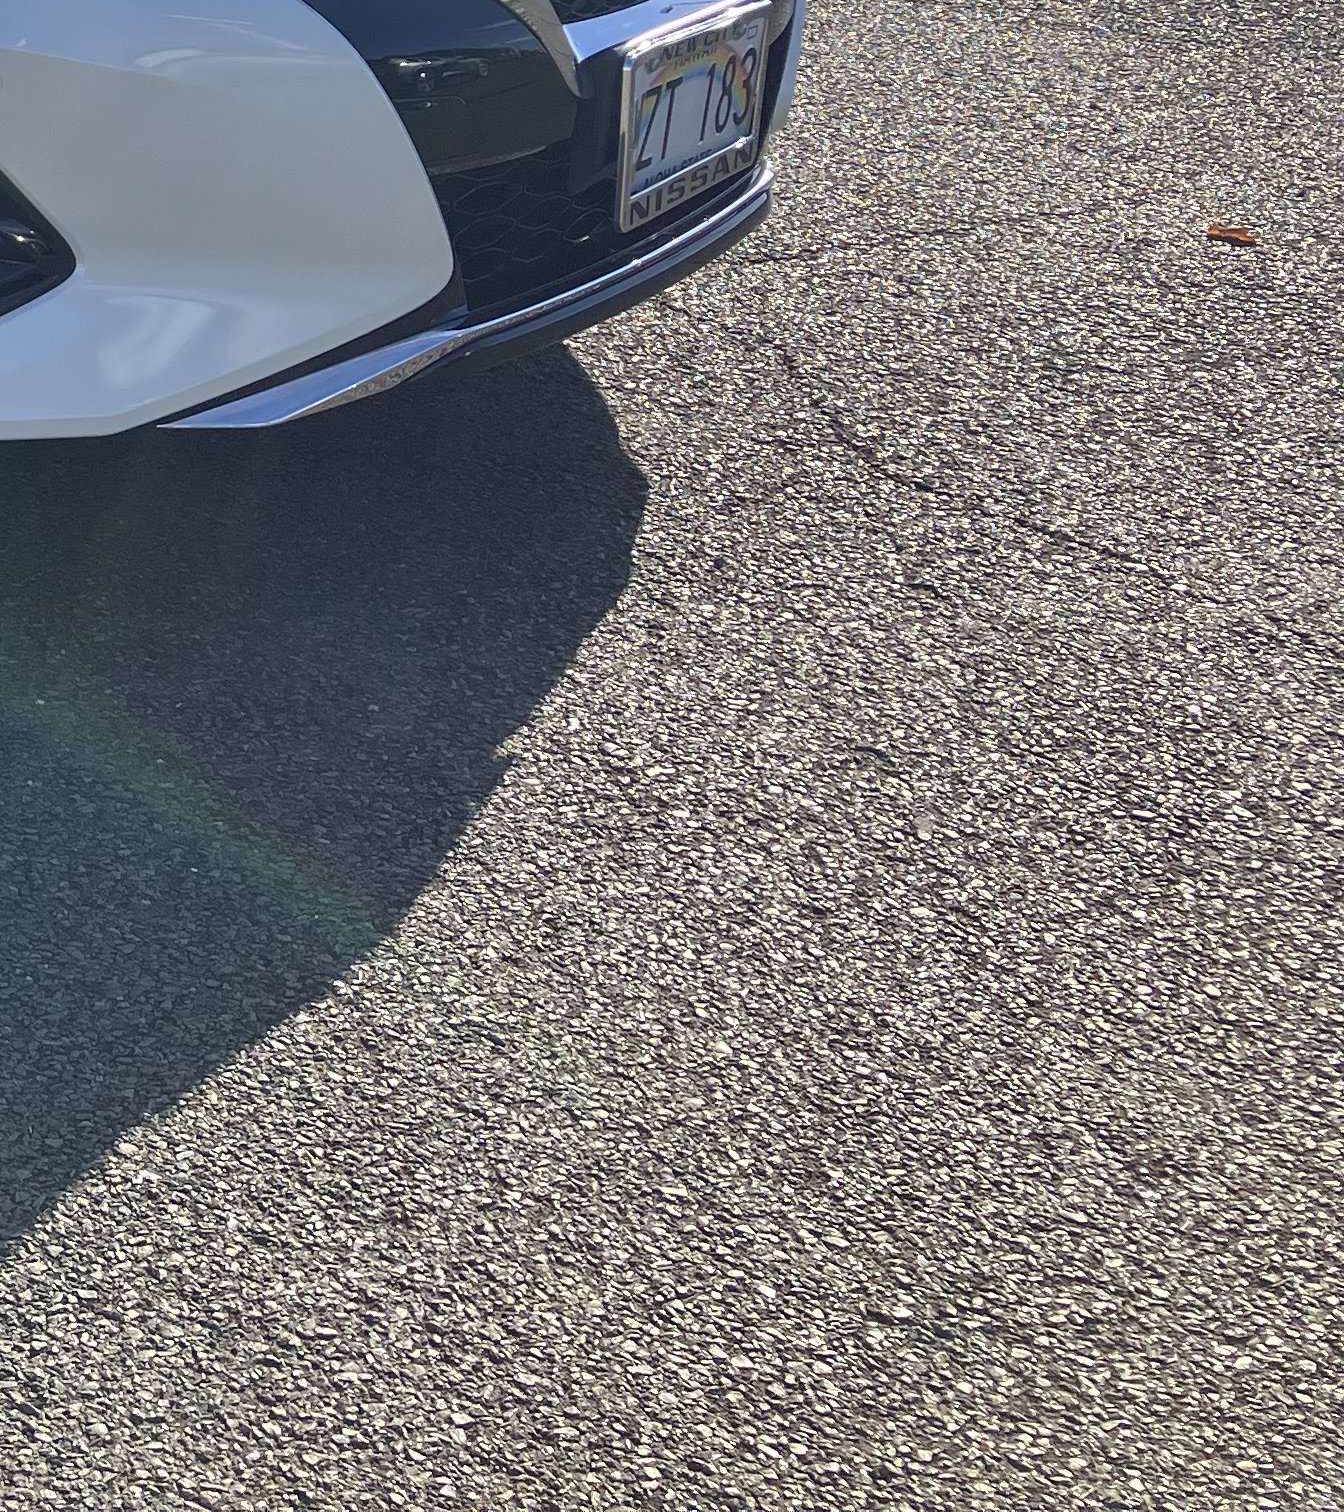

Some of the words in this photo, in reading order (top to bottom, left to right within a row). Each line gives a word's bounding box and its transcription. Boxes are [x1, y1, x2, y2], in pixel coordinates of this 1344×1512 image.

[635, 76, 684, 172] ZT
[699, 47, 756, 142] 183
[630, 145, 754, 226] NISSAN
